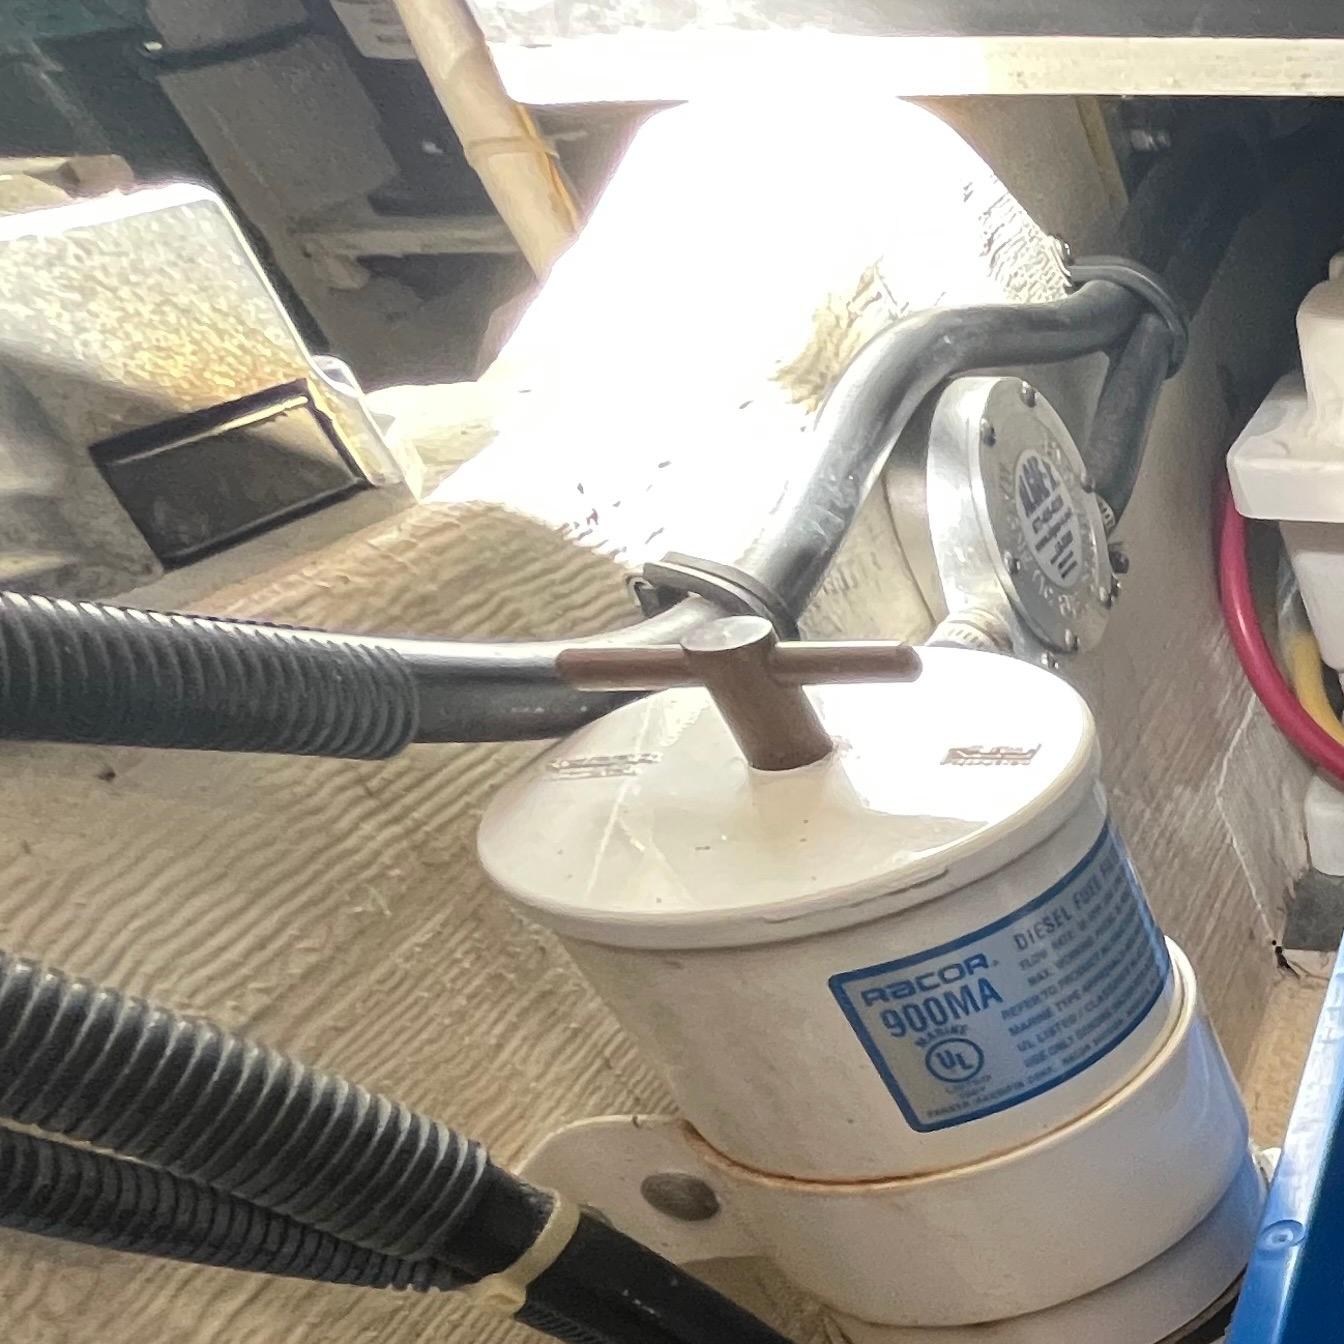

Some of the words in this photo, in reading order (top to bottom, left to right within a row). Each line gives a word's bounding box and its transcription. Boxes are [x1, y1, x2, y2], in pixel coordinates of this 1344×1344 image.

[1012, 903, 1074, 950] DIESEL
[880, 977, 1003, 1038] 900MA
[935, 1049, 974, 1071] UL
